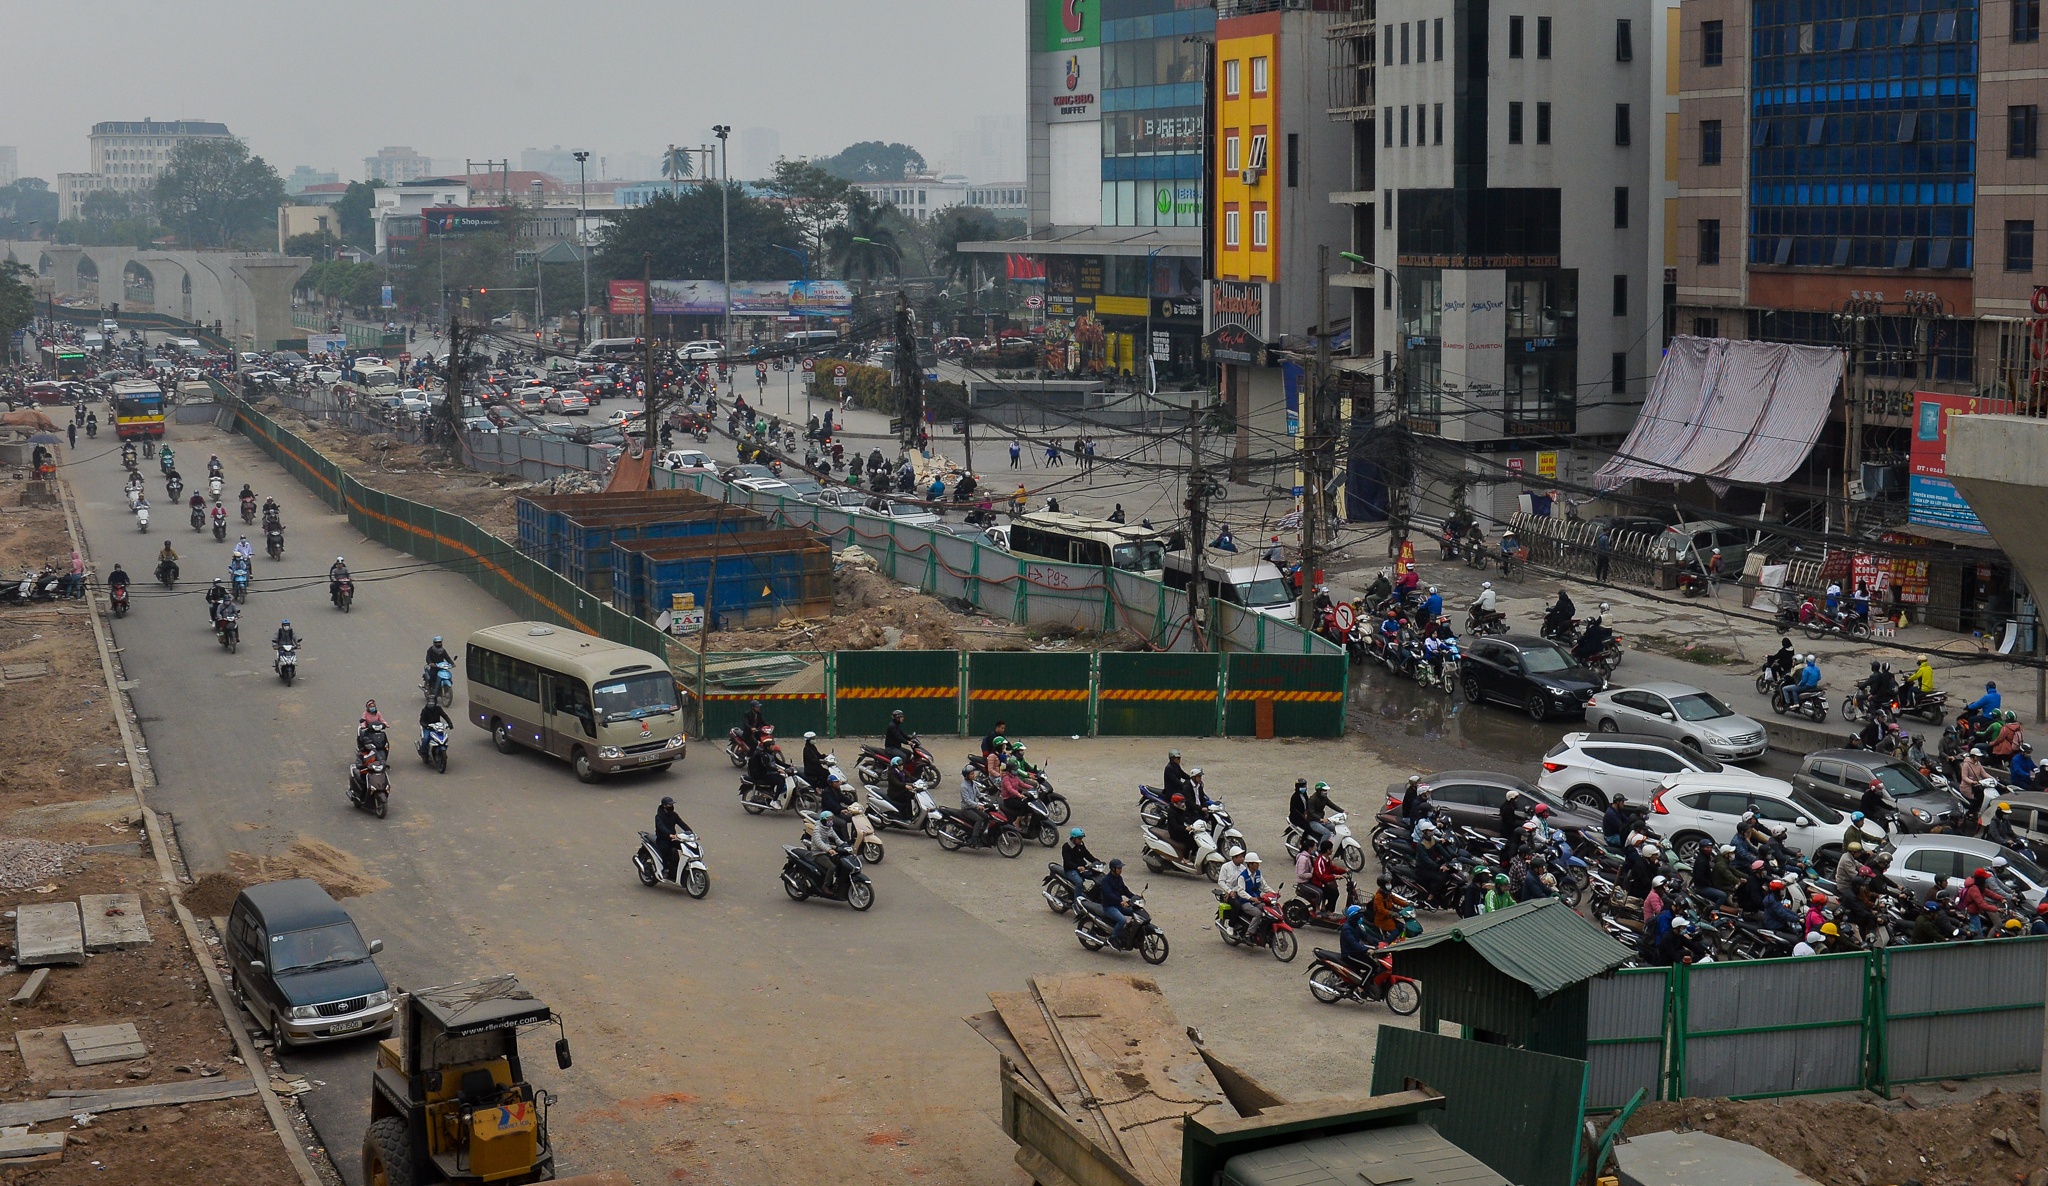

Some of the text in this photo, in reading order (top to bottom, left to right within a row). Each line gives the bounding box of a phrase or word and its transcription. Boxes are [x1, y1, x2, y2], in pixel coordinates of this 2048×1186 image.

[1061, 106, 1086, 115] BUFFET
[1467, 381, 1491, 390] American
[672, 614, 703, 624] TẤT
